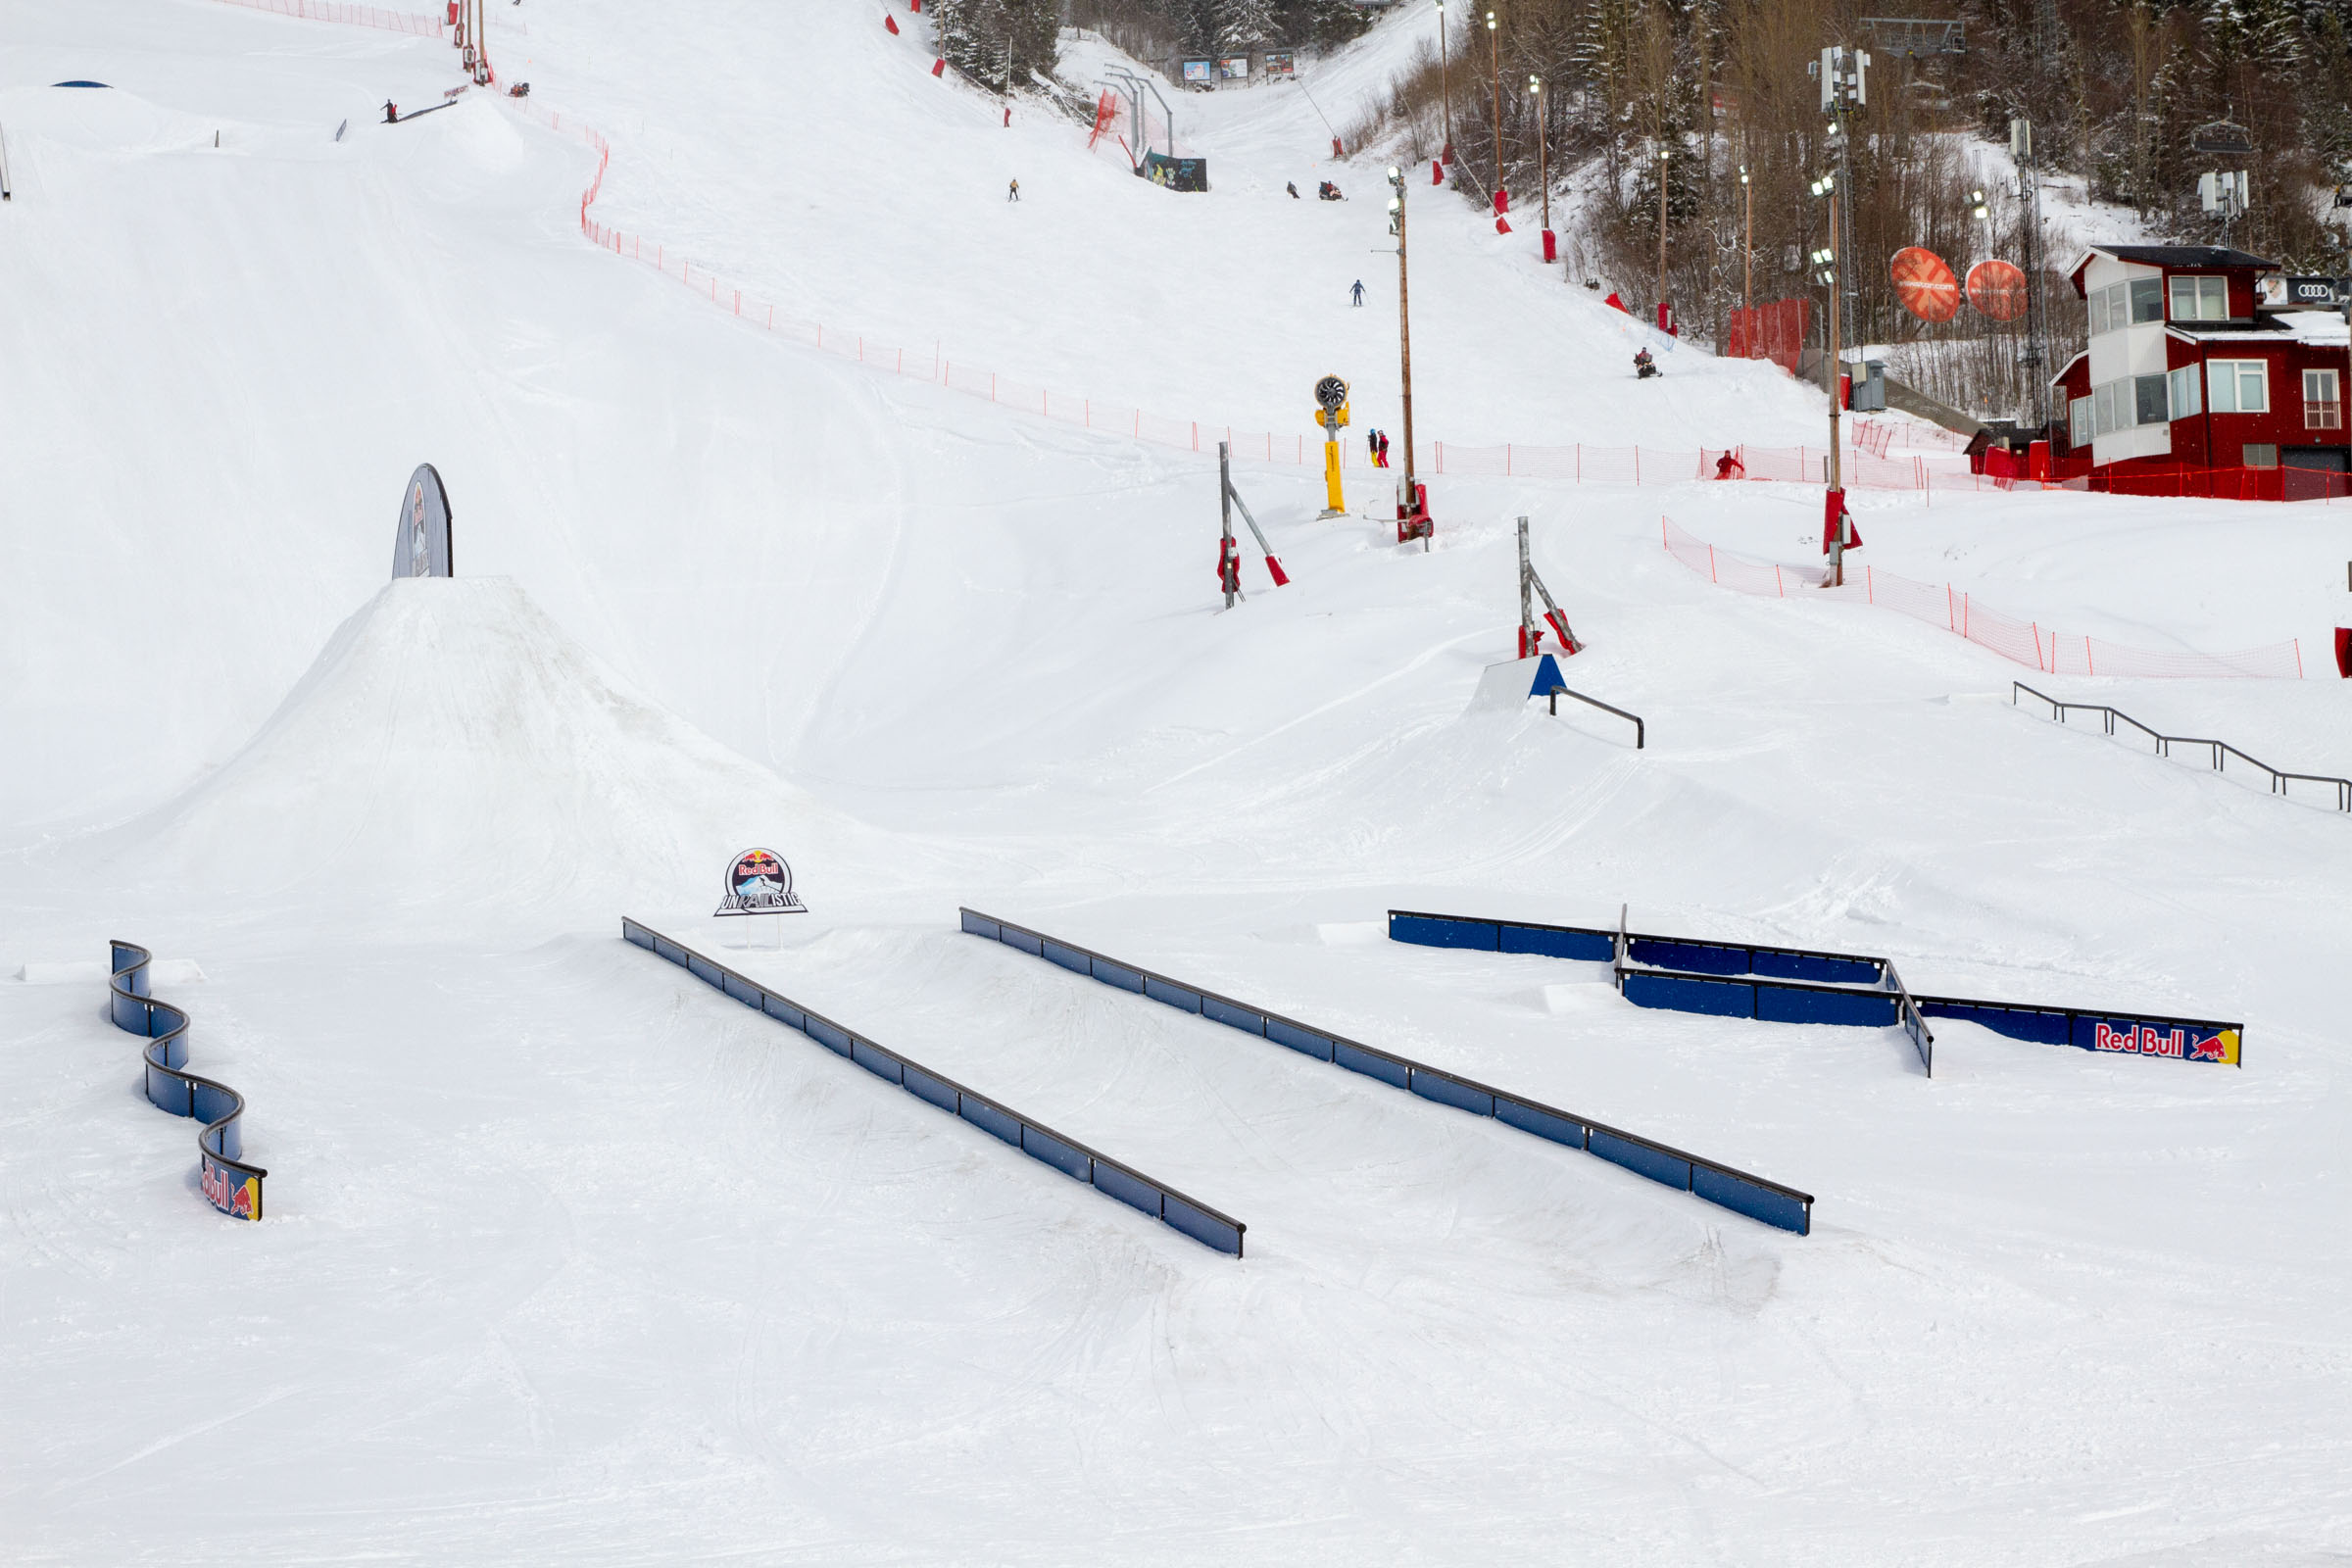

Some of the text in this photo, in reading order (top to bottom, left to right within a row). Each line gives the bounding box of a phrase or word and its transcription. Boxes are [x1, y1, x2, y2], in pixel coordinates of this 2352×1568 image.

[739, 863, 778, 875] Red Bull
[721, 892, 802, 908] UNRAILISTIC
[2095, 1023, 2184, 1057] Red Bull
